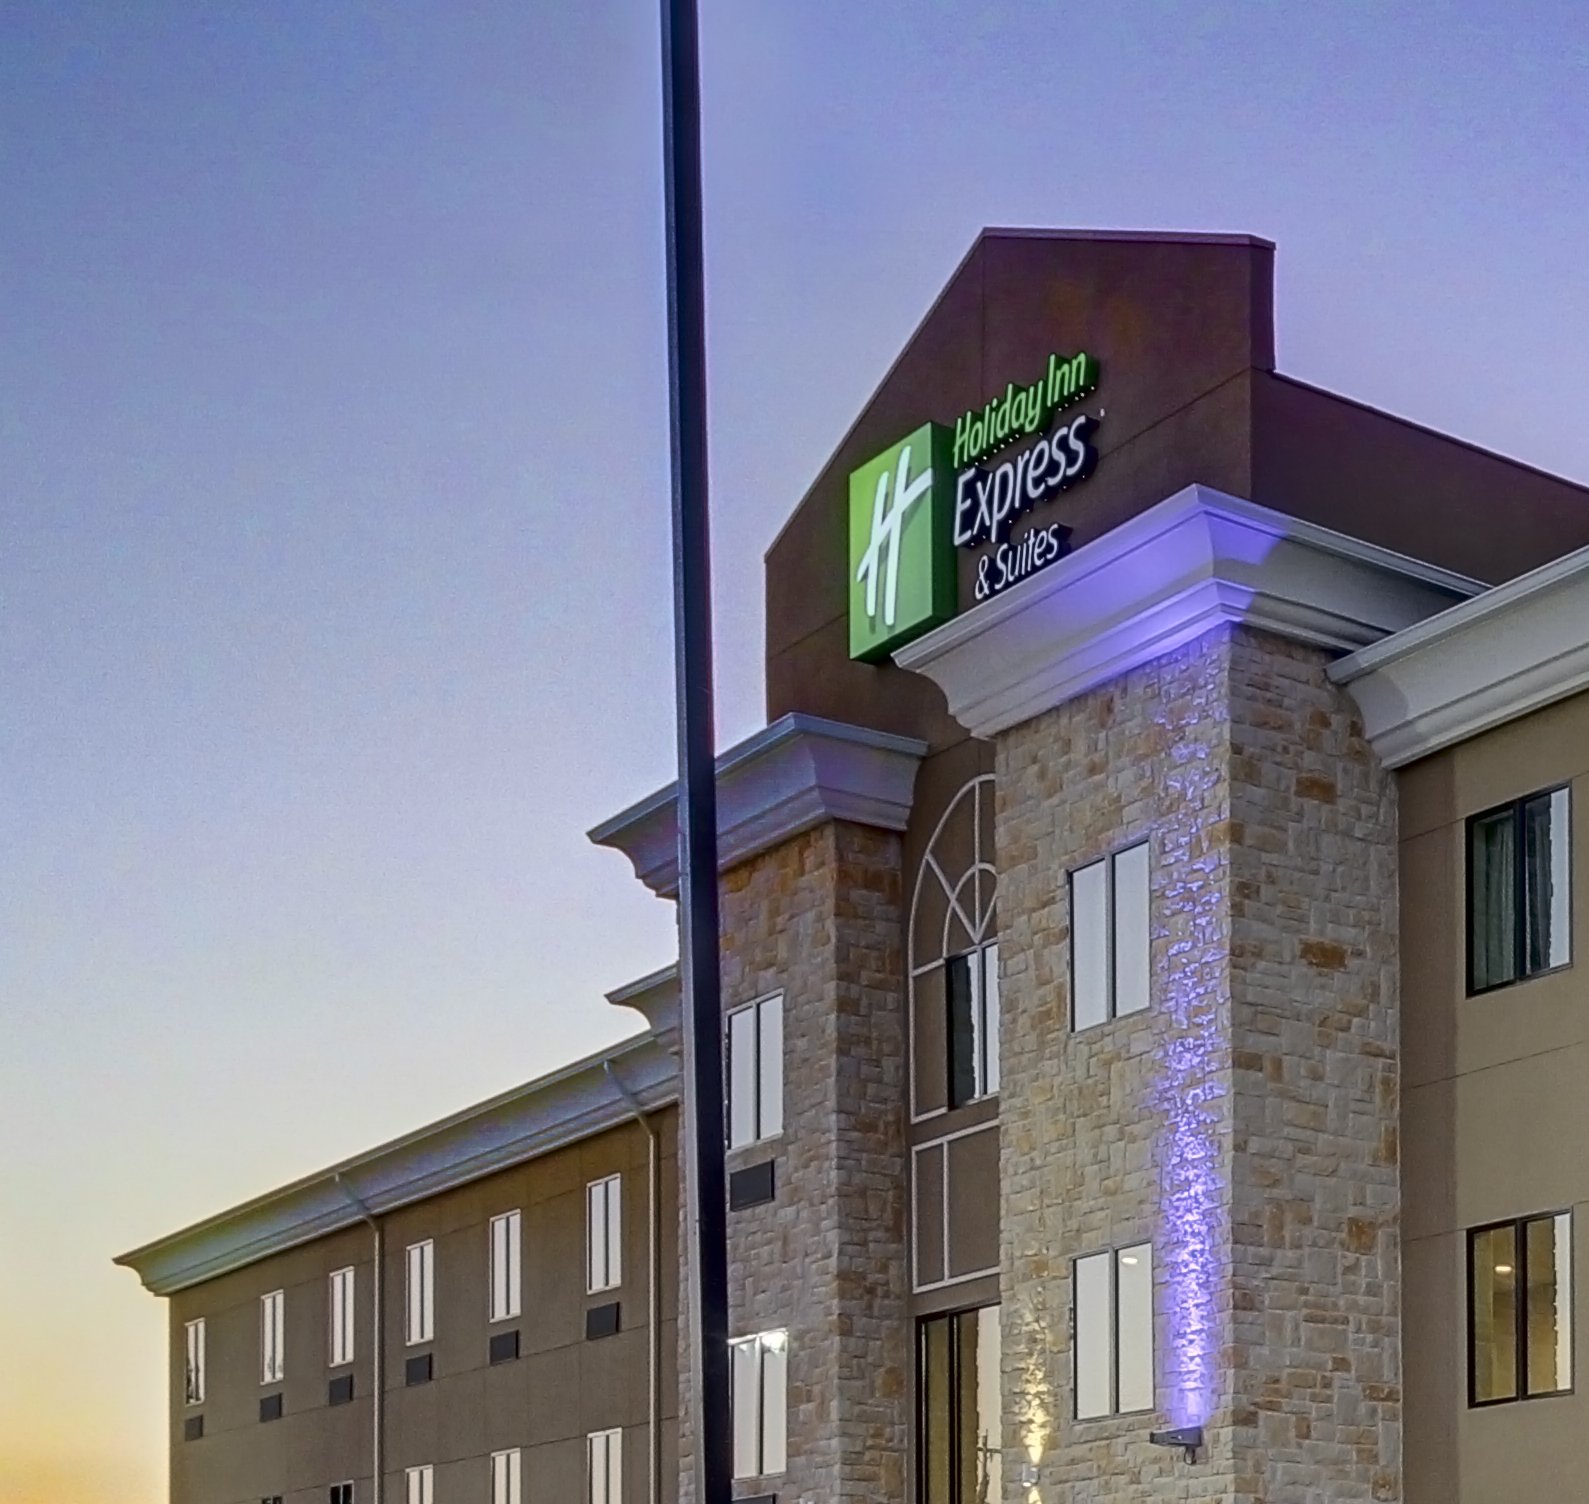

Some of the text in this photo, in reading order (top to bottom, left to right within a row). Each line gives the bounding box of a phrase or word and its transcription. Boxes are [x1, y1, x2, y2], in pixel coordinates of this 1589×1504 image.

[953, 352, 1087, 468] Holiday Inn
[953, 414, 1087, 547] Express
[975, 523, 1060, 600] & Suites
